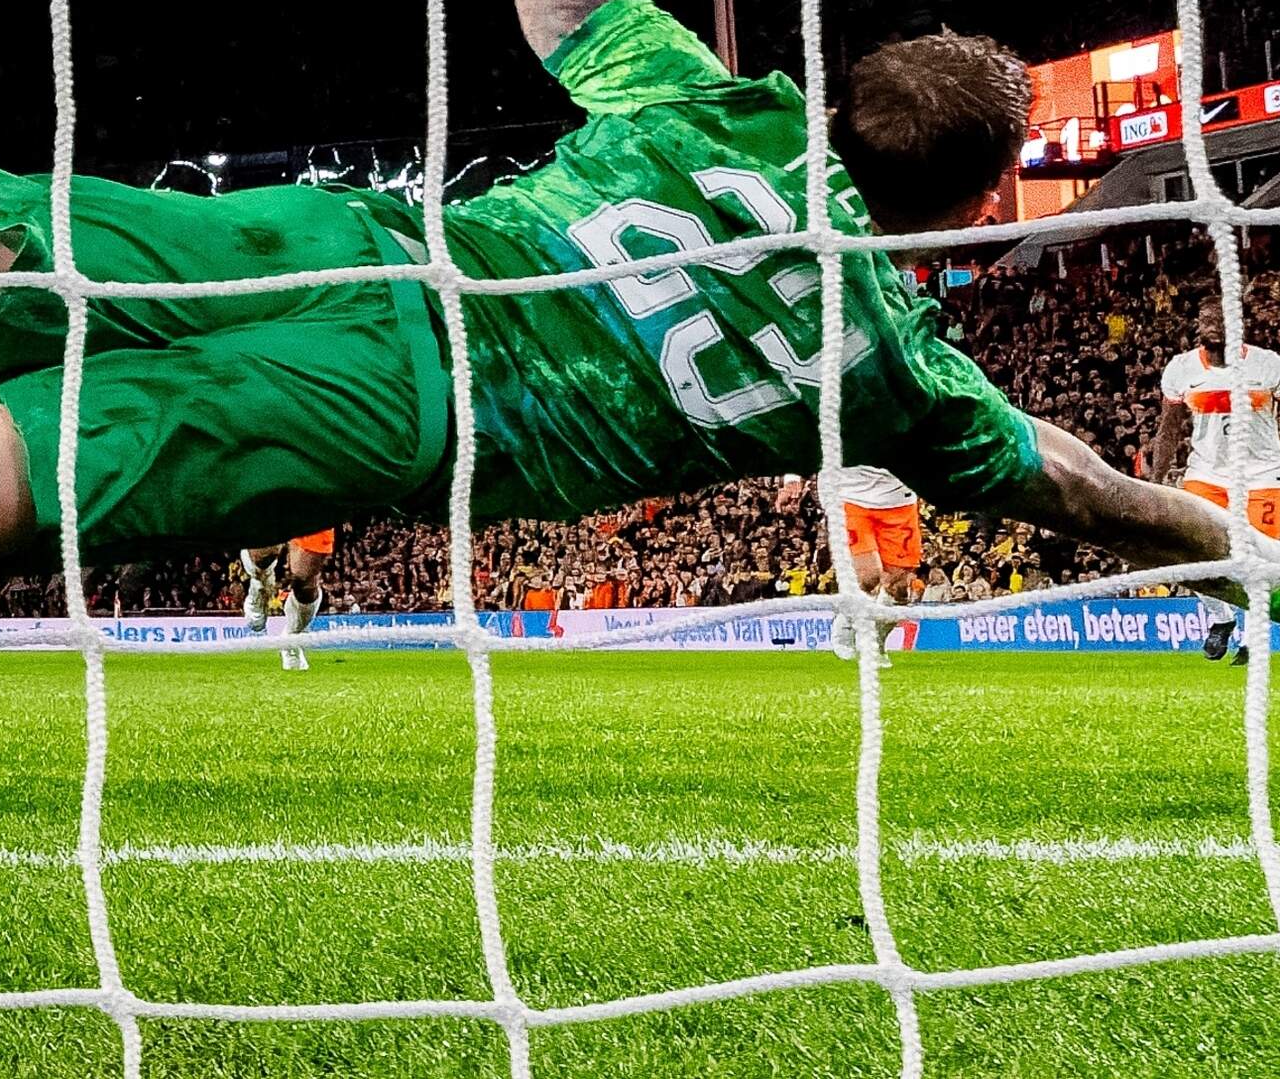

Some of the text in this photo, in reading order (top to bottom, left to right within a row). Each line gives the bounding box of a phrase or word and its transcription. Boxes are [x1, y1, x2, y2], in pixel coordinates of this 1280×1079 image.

[1124, 121, 1148, 141] ING
[101, 621, 165, 643] elers
[1023, 607, 1079, 649] eten,
[1082, 605, 1148, 642] beter
[1155, 602, 1218, 649] spel
